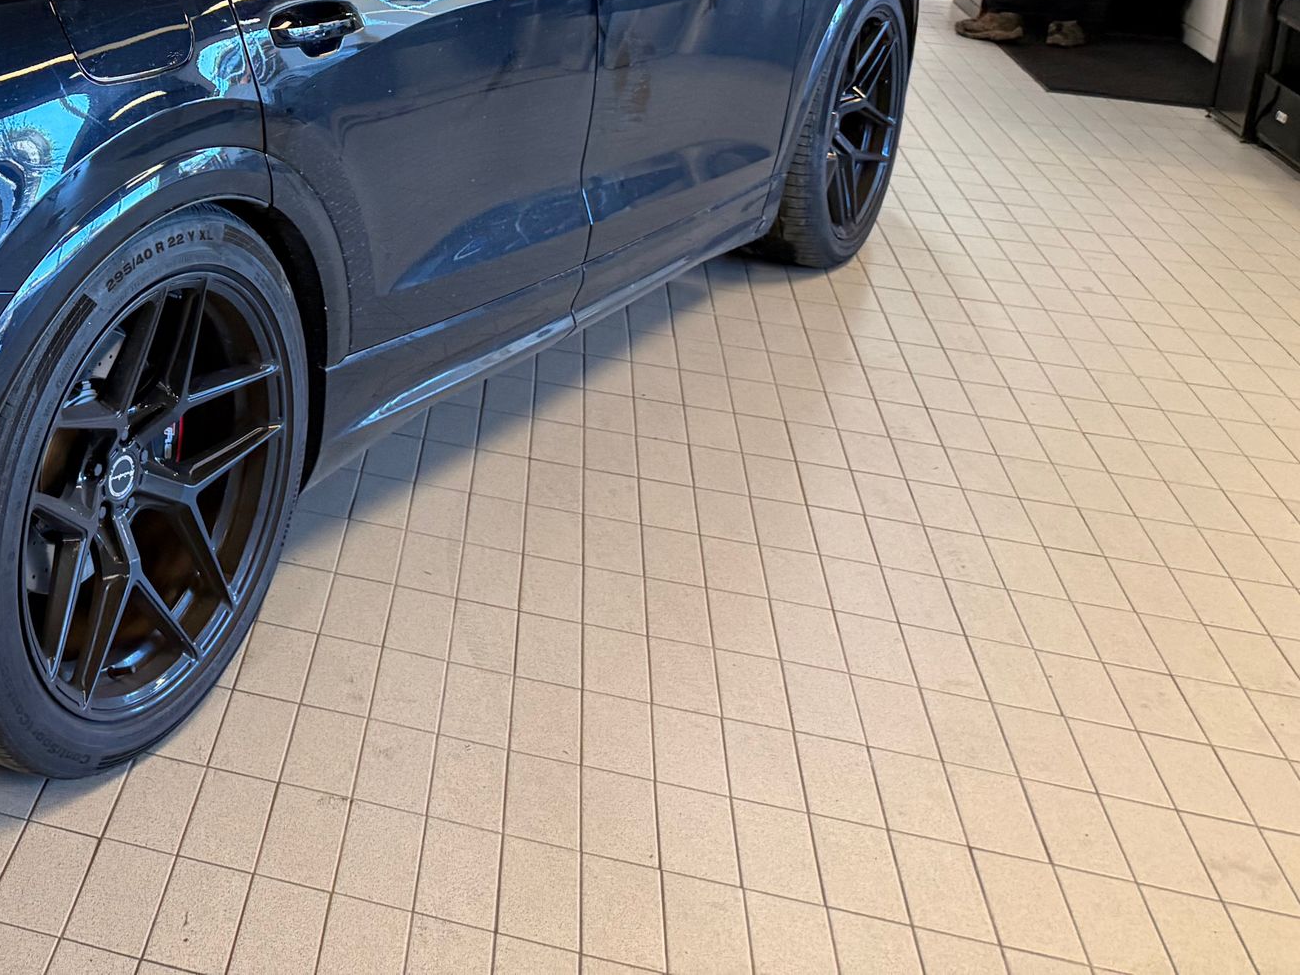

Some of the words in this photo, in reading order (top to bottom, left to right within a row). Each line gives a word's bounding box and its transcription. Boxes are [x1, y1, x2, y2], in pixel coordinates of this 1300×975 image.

[106, 248, 153, 293] 295/40
[155, 241, 165, 254] R
[167, 233, 185, 249] 22
[199, 229, 213, 241] XL
